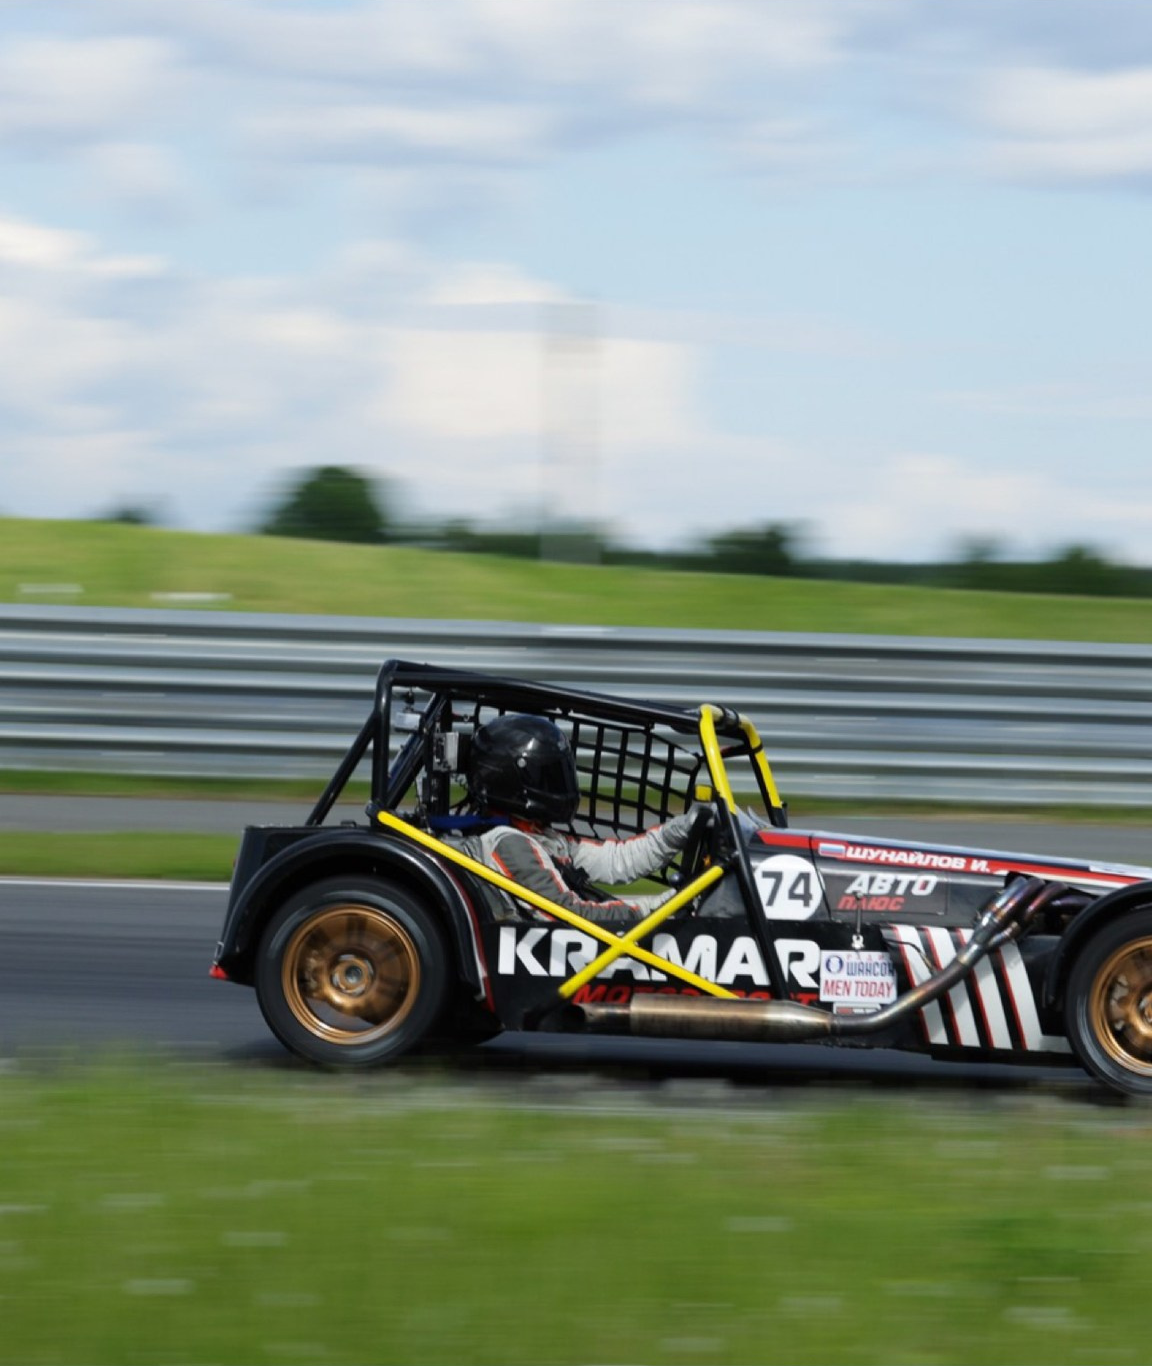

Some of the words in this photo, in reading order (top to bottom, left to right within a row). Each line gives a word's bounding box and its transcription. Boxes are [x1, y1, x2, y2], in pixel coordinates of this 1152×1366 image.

[846, 846, 967, 870] ШУНАЙЛОВ
[970, 859, 990, 872] И.
[761, 871, 813, 908] 74
[845, 873, 938, 896] АВТО
[838, 896, 905, 911] ПЛЮС
[498, 926, 820, 988] KRAMAR
[846, 961, 895, 977] ШАНСОН
[823, 980, 852, 996] MEN
[855, 981, 893, 997] TODAY
